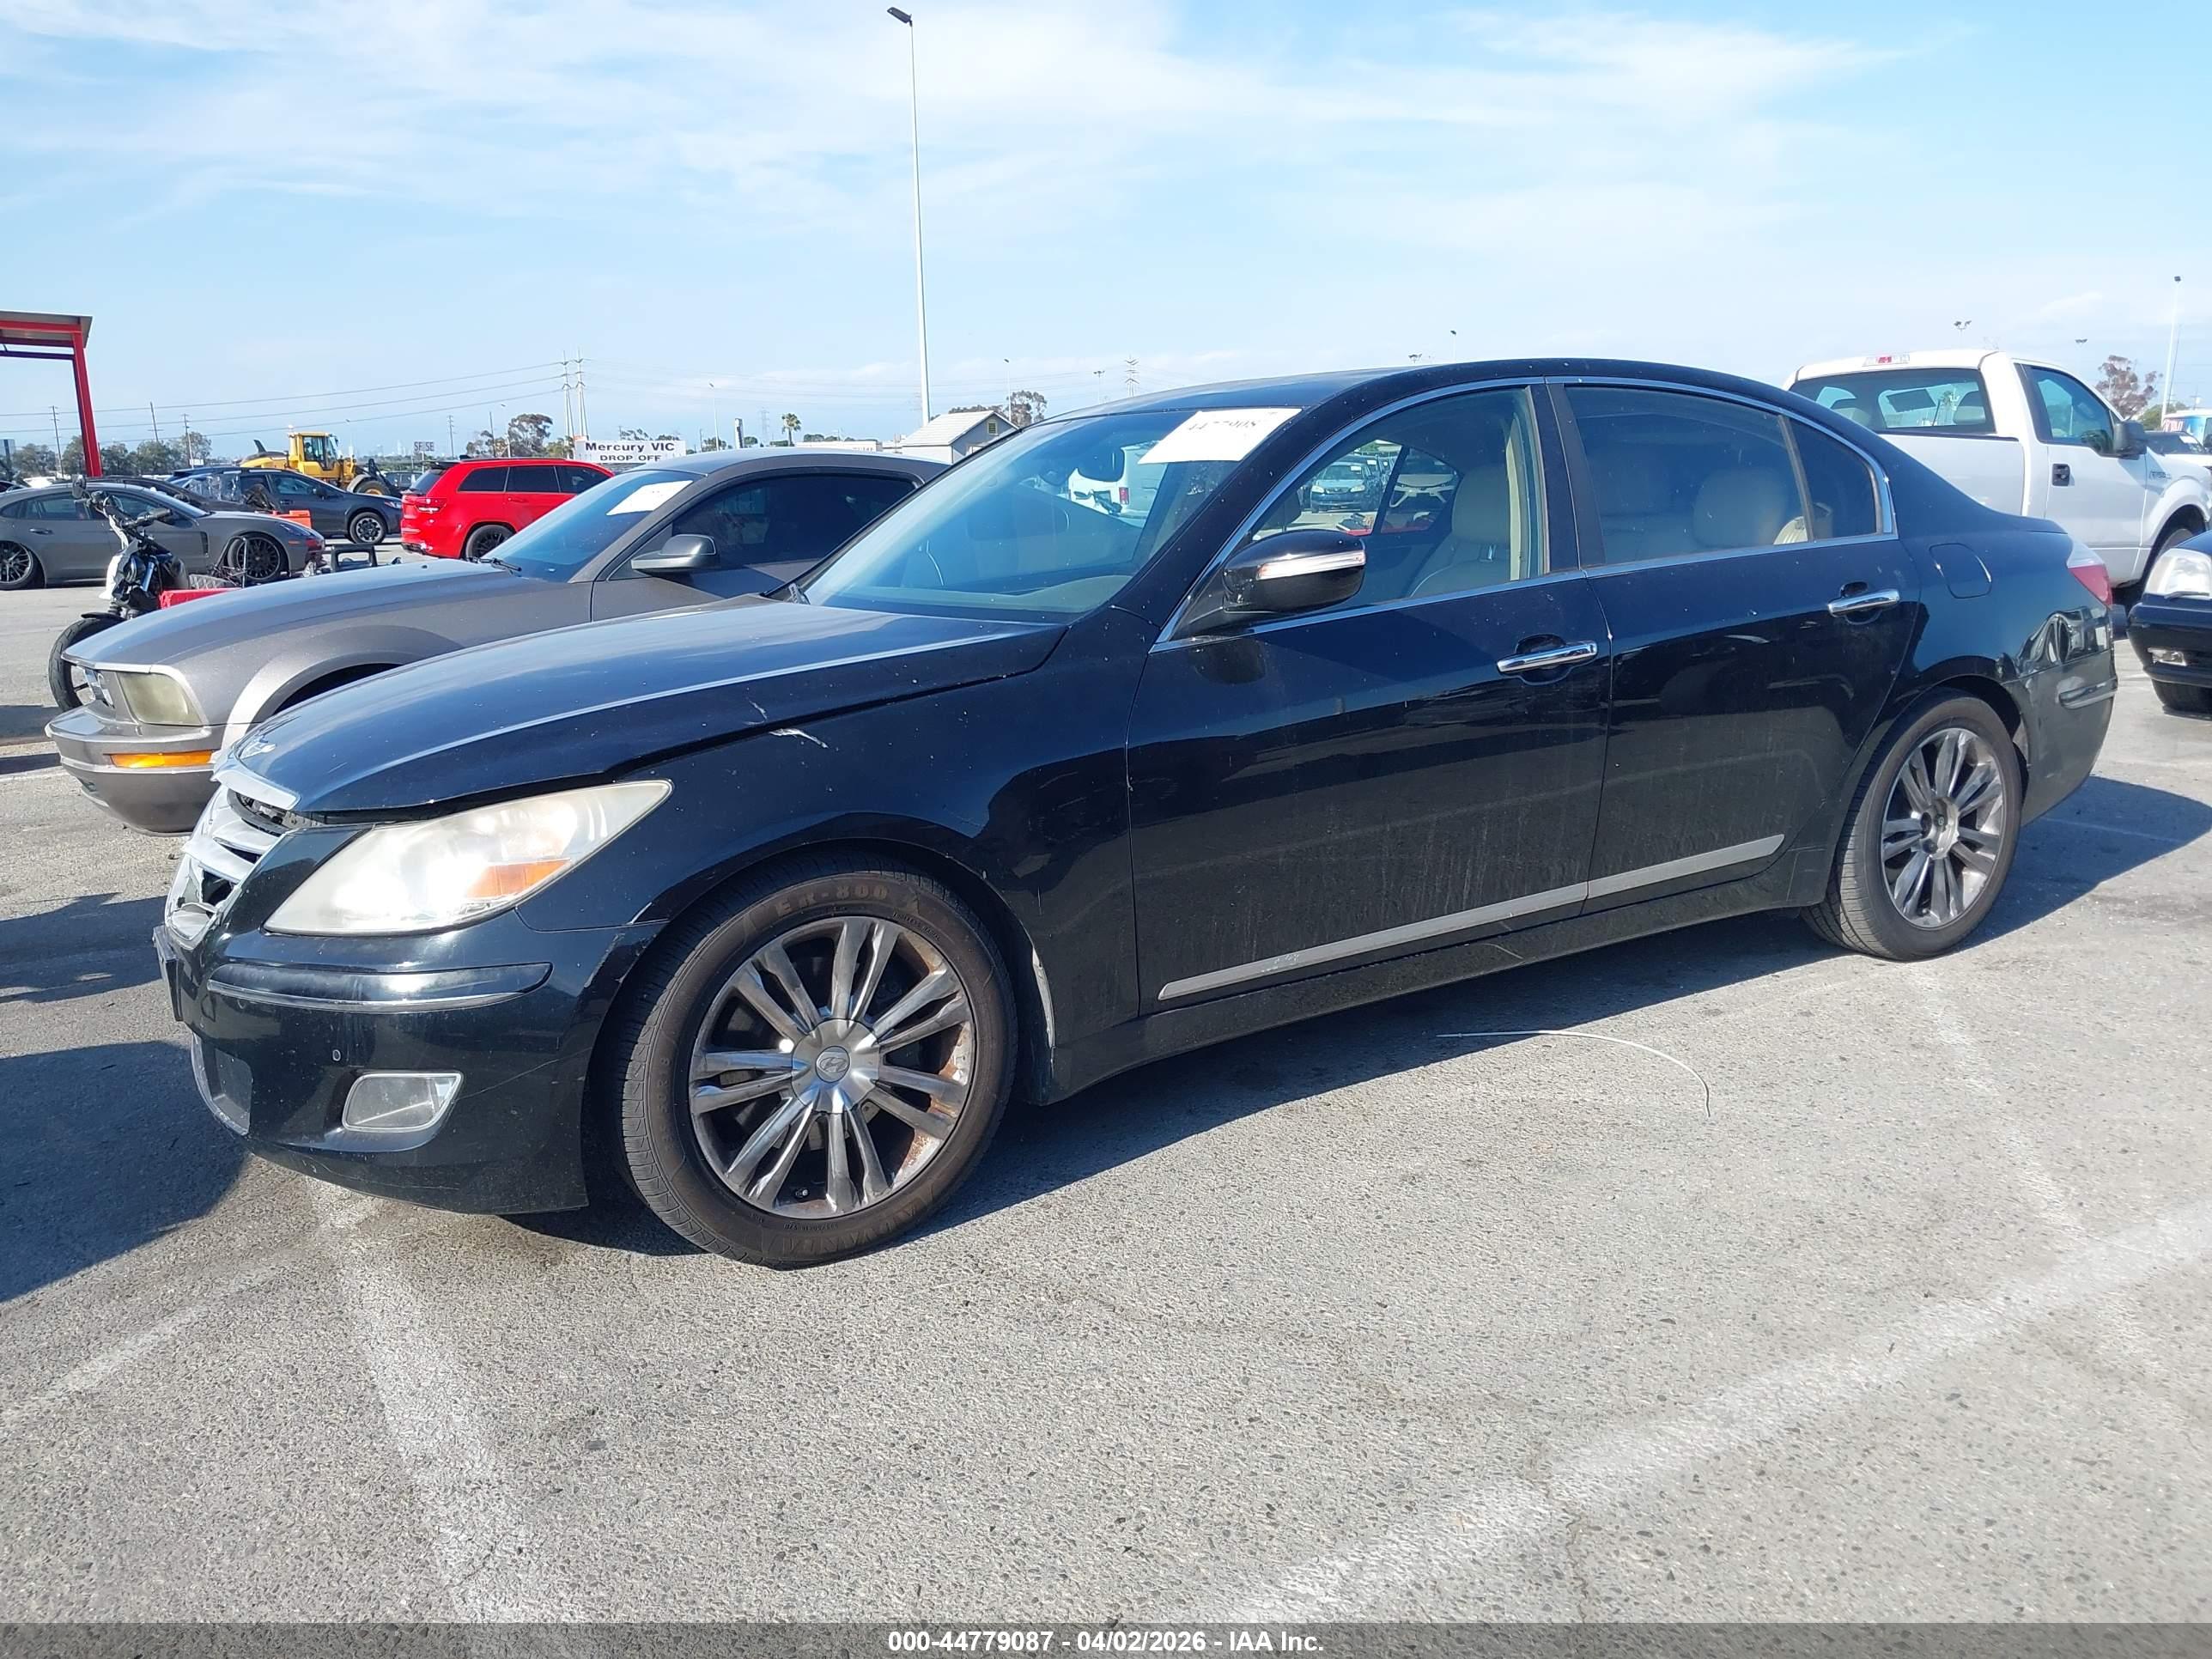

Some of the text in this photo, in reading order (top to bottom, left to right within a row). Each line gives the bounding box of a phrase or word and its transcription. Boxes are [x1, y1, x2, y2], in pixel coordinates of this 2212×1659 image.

[425, 441, 434, 452] SE
[585, 441, 675, 453] Mercury VIC
